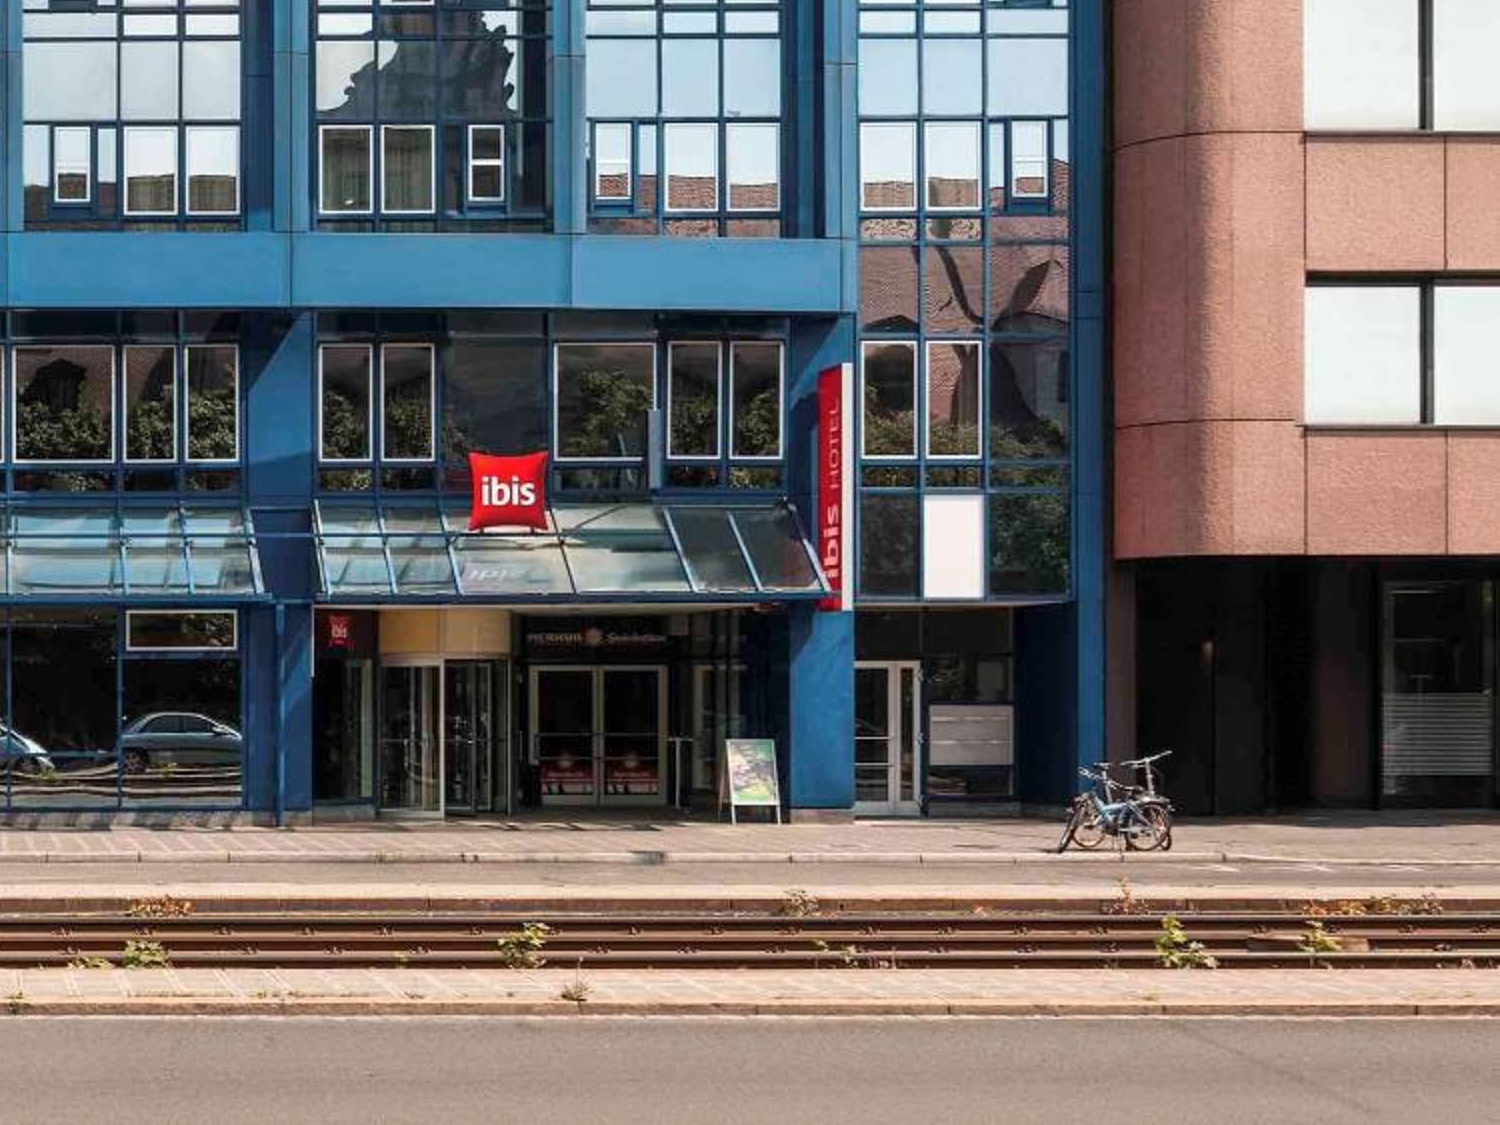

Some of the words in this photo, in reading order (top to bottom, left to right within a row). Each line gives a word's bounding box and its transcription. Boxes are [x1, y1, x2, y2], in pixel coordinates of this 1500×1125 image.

[829, 397, 840, 490] HOTEL
[481, 475, 536, 507] ibis
[823, 503, 840, 579] ibis
